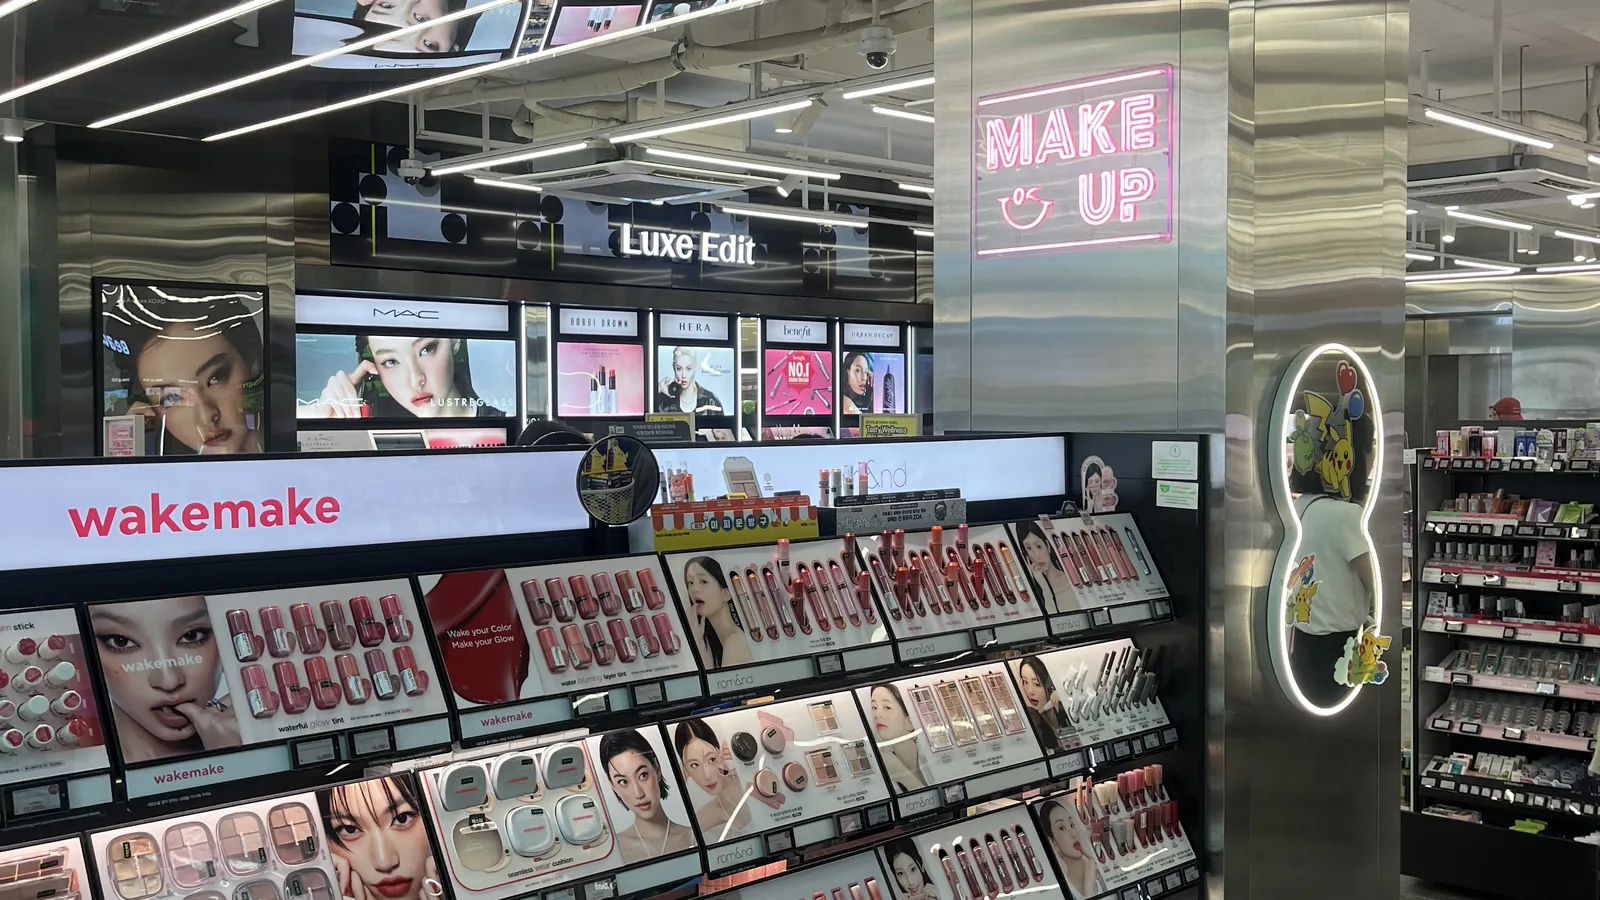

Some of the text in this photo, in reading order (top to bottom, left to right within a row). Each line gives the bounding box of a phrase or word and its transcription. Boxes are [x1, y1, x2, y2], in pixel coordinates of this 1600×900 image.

[986, 93, 1157, 170] MAKE
[1079, 167, 1156, 225] UP
[621, 223, 756, 265] Luxe Edit
[570, 317, 629, 329] BOBBI BROWN
[679, 322, 711, 332] HERA
[783, 325, 812, 338] benefit
[430, 397, 514, 408] LUSTREGLASS
[68, 486, 341, 538] wakemake
[13, 622, 35, 631] stick
[447, 623, 512, 638] Wake your Color
[452, 634, 515, 649] Make your Glow
[121, 653, 204, 673] wakemake
[560, 679, 577, 687] water
[603, 672, 616, 682] layer
[617, 671, 627, 679] tint
[278, 717, 345, 733] waterful glow tint
[480, 711, 533, 728] wakemake
[153, 765, 225, 785] wakemake
[507, 867, 534, 878] seamless
[552, 857, 574, 867] cushion
